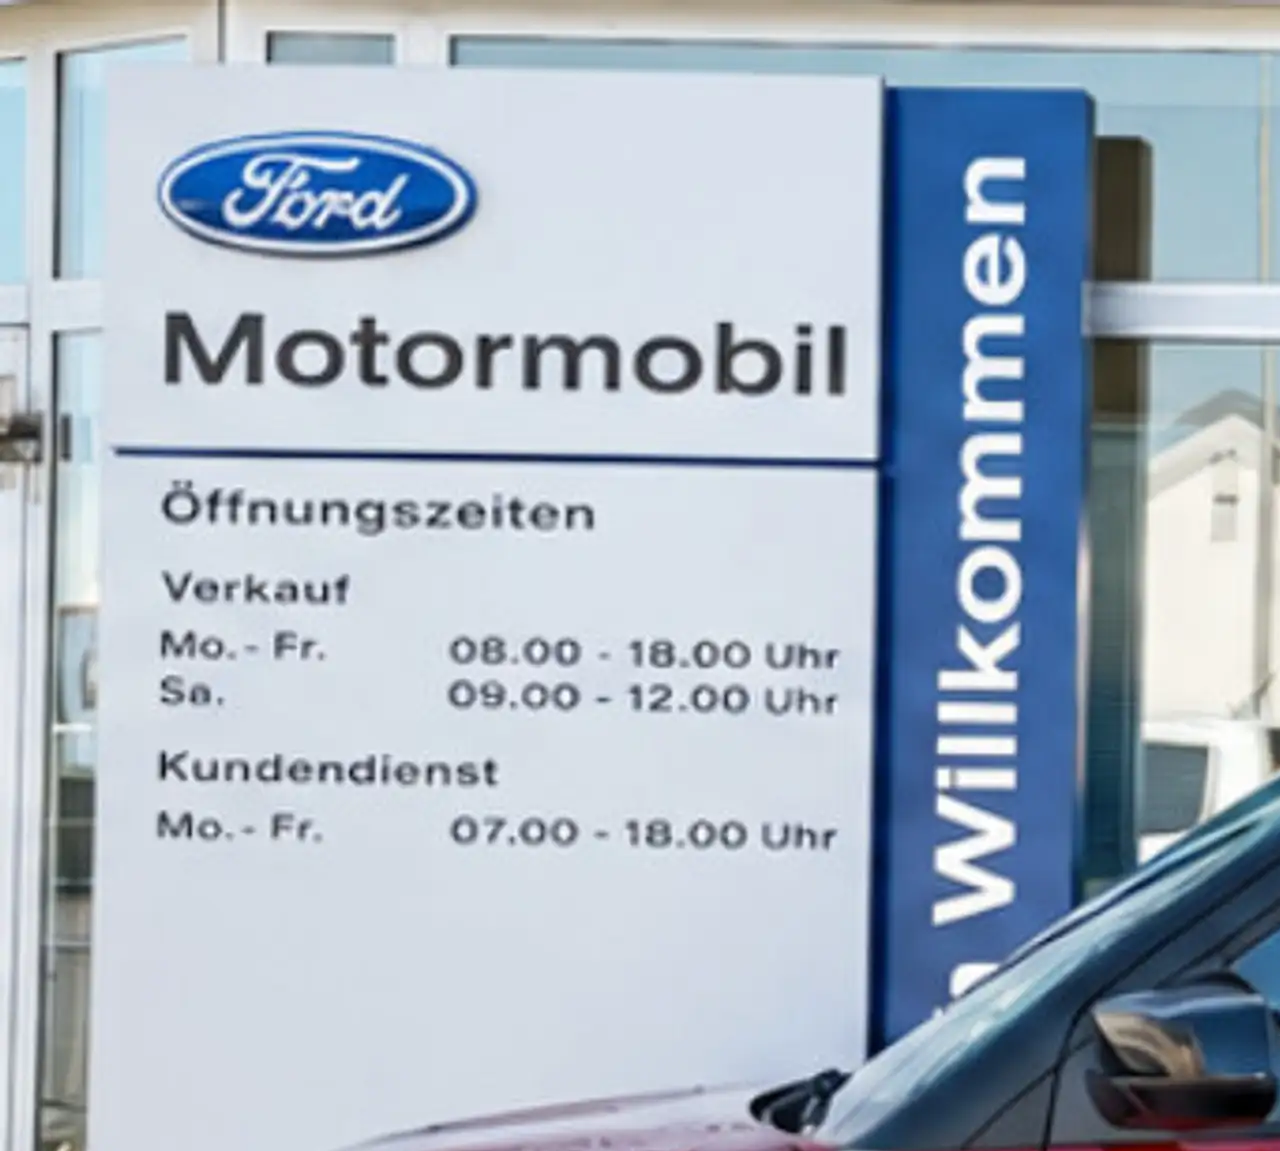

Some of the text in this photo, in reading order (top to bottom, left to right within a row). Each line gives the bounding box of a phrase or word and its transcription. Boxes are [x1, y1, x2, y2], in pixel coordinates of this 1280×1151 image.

[221, 152, 410, 231] Ford
[163, 310, 848, 397] Motormobil
[161, 480, 597, 536] Öffnungszeiten
[931, 155, 1027, 927] Willkommen
[162, 571, 350, 606] Verkauf
[271, 629, 328, 662] Fr.
[448, 635, 583, 667] 08.00
[628, 639, 753, 670] 18.00
[764, 642, 841, 671] Uhr
[446, 678, 582, 712] 09.00
[627, 683, 752, 714] 12.00
[763, 687, 839, 717] Uhr
[157, 750, 499, 788] Kundendienst
[269, 811, 324, 844] Fr.
[449, 815, 580, 848] 07.00
[625, 818, 749, 850] 18.00
[760, 822, 839, 852] Uhr
